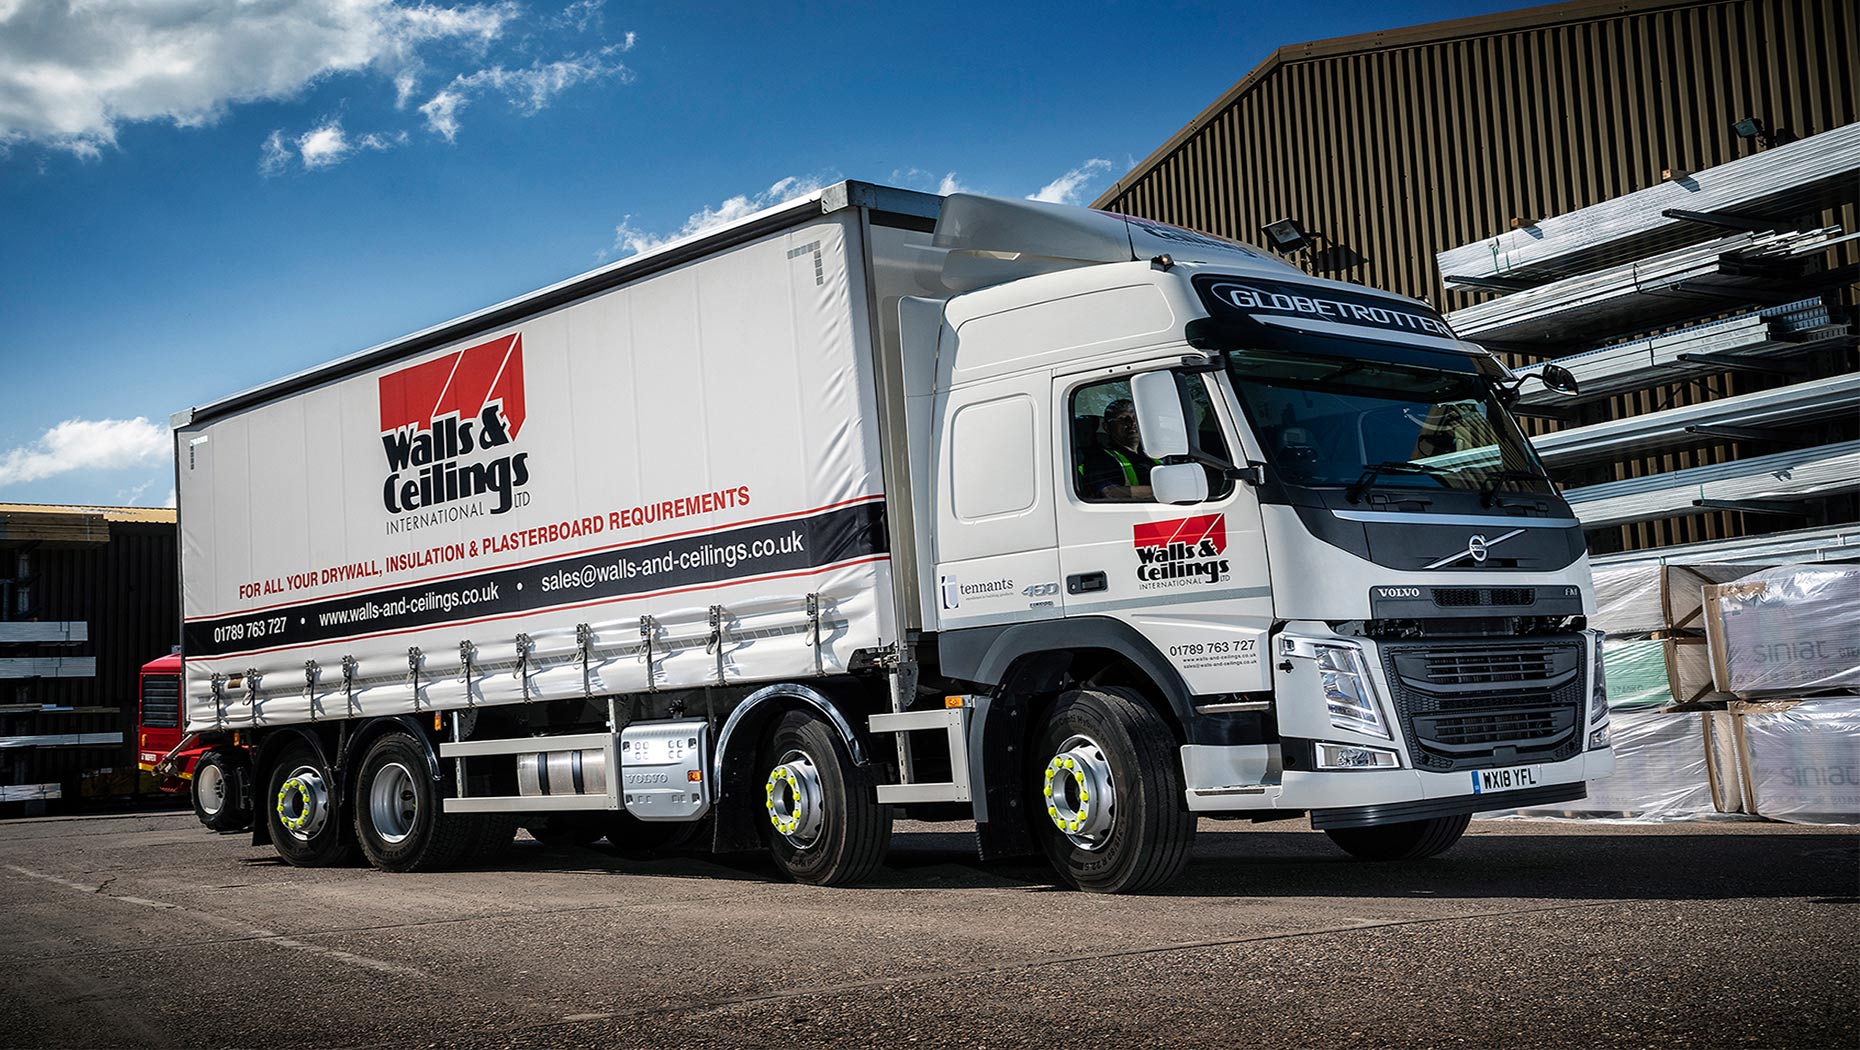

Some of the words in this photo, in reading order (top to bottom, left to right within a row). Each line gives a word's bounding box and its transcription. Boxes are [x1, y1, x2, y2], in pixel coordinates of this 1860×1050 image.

[1229, 290, 1455, 338] GLOBETROTTER
[381, 416, 475, 473] Walls
[479, 404, 509, 450] &
[383, 452, 530, 515] Ceilings
[386, 501, 485, 535] INTERNATIONAL
[514, 491, 531, 508] LTD
[239, 582, 261, 600] FOR
[263, 577, 284, 595] ALL
[286, 571, 319, 591] YOUR
[321, 559, 383, 585] DRYWALL,
[386, 542, 465, 573] INSULATION
[469, 540, 479, 558] &
[482, 514, 605, 555] PLASTERBOARD
[608, 485, 751, 531] REQUIREMENTS
[1136, 542, 1196, 564] Walls
[1198, 539, 1218, 557] &
[1137, 560, 1230, 584] Ceilings
[1139, 577, 1202, 591] INTERNATIONAL
[1220, 574, 1231, 583] LTD
[213, 623, 244, 643] 01789
[246, 620, 266, 639] 763
[268, 616, 287, 635] 727
[318, 581, 500, 627] www.walls-and-ceilings.co.uk
[541, 529, 805, 592] sales@walls-and-ceilings.co.uk
[960, 578, 1014, 595] tennants
[1377, 587, 1420, 598] VOLVO
[1565, 587, 1578, 596] FM
[1169, 643, 1204, 657] 01789
[1207, 641, 1230, 654] 763
[1232, 639, 1256, 652] 727
[1752, 640, 1829, 664] siniat
[625, 773, 669, 784] VOLVO
[1483, 770, 1512, 790] WX18
[1513, 767, 1537, 786] YFL
